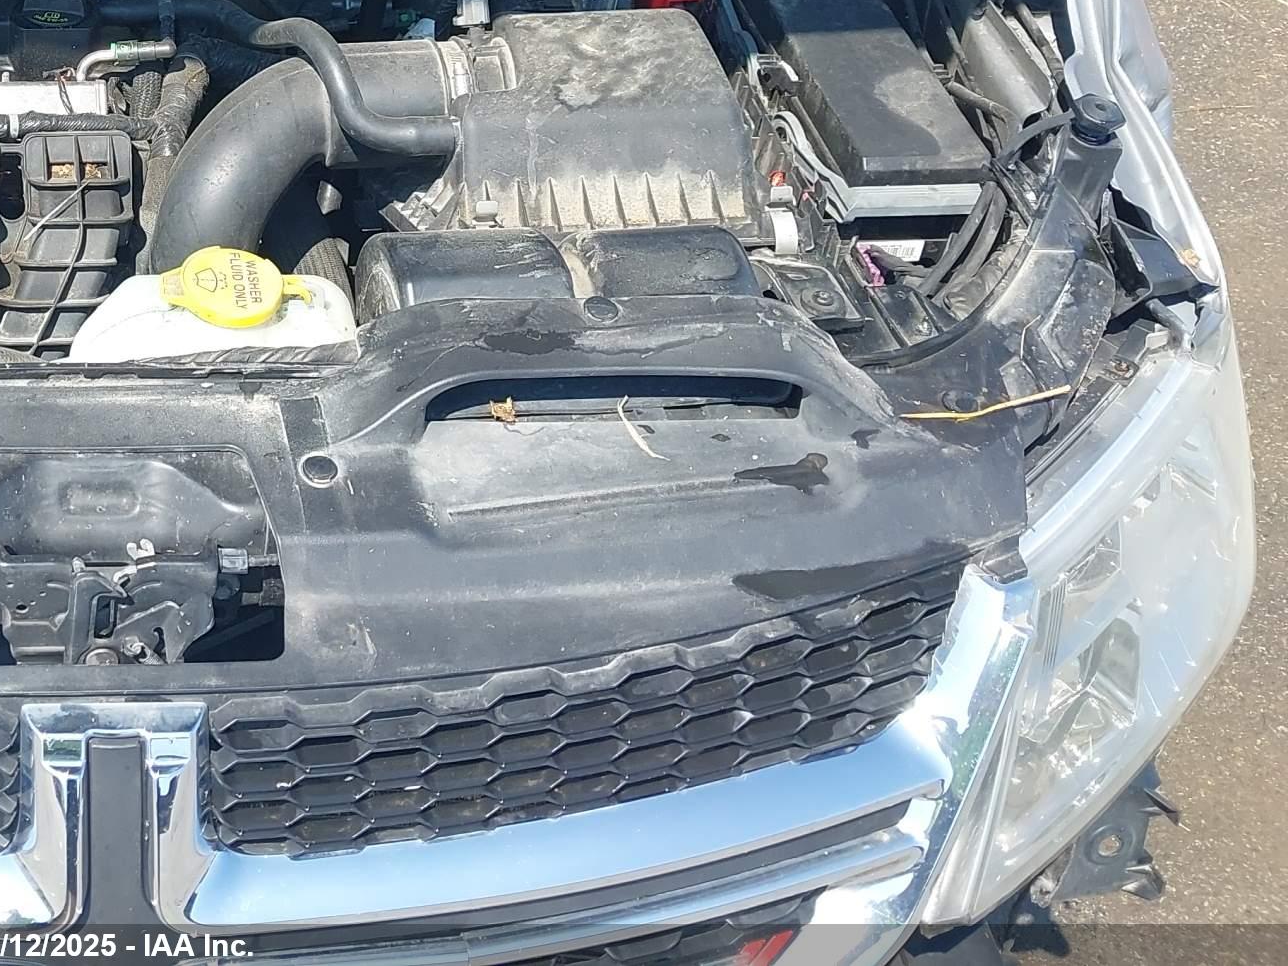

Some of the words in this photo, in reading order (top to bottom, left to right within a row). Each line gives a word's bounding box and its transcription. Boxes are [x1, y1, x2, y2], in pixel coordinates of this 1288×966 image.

[229, 252, 244, 281] FLUID
[233, 283, 248, 309] ONLY
[245, 260, 263, 304] WASHER
